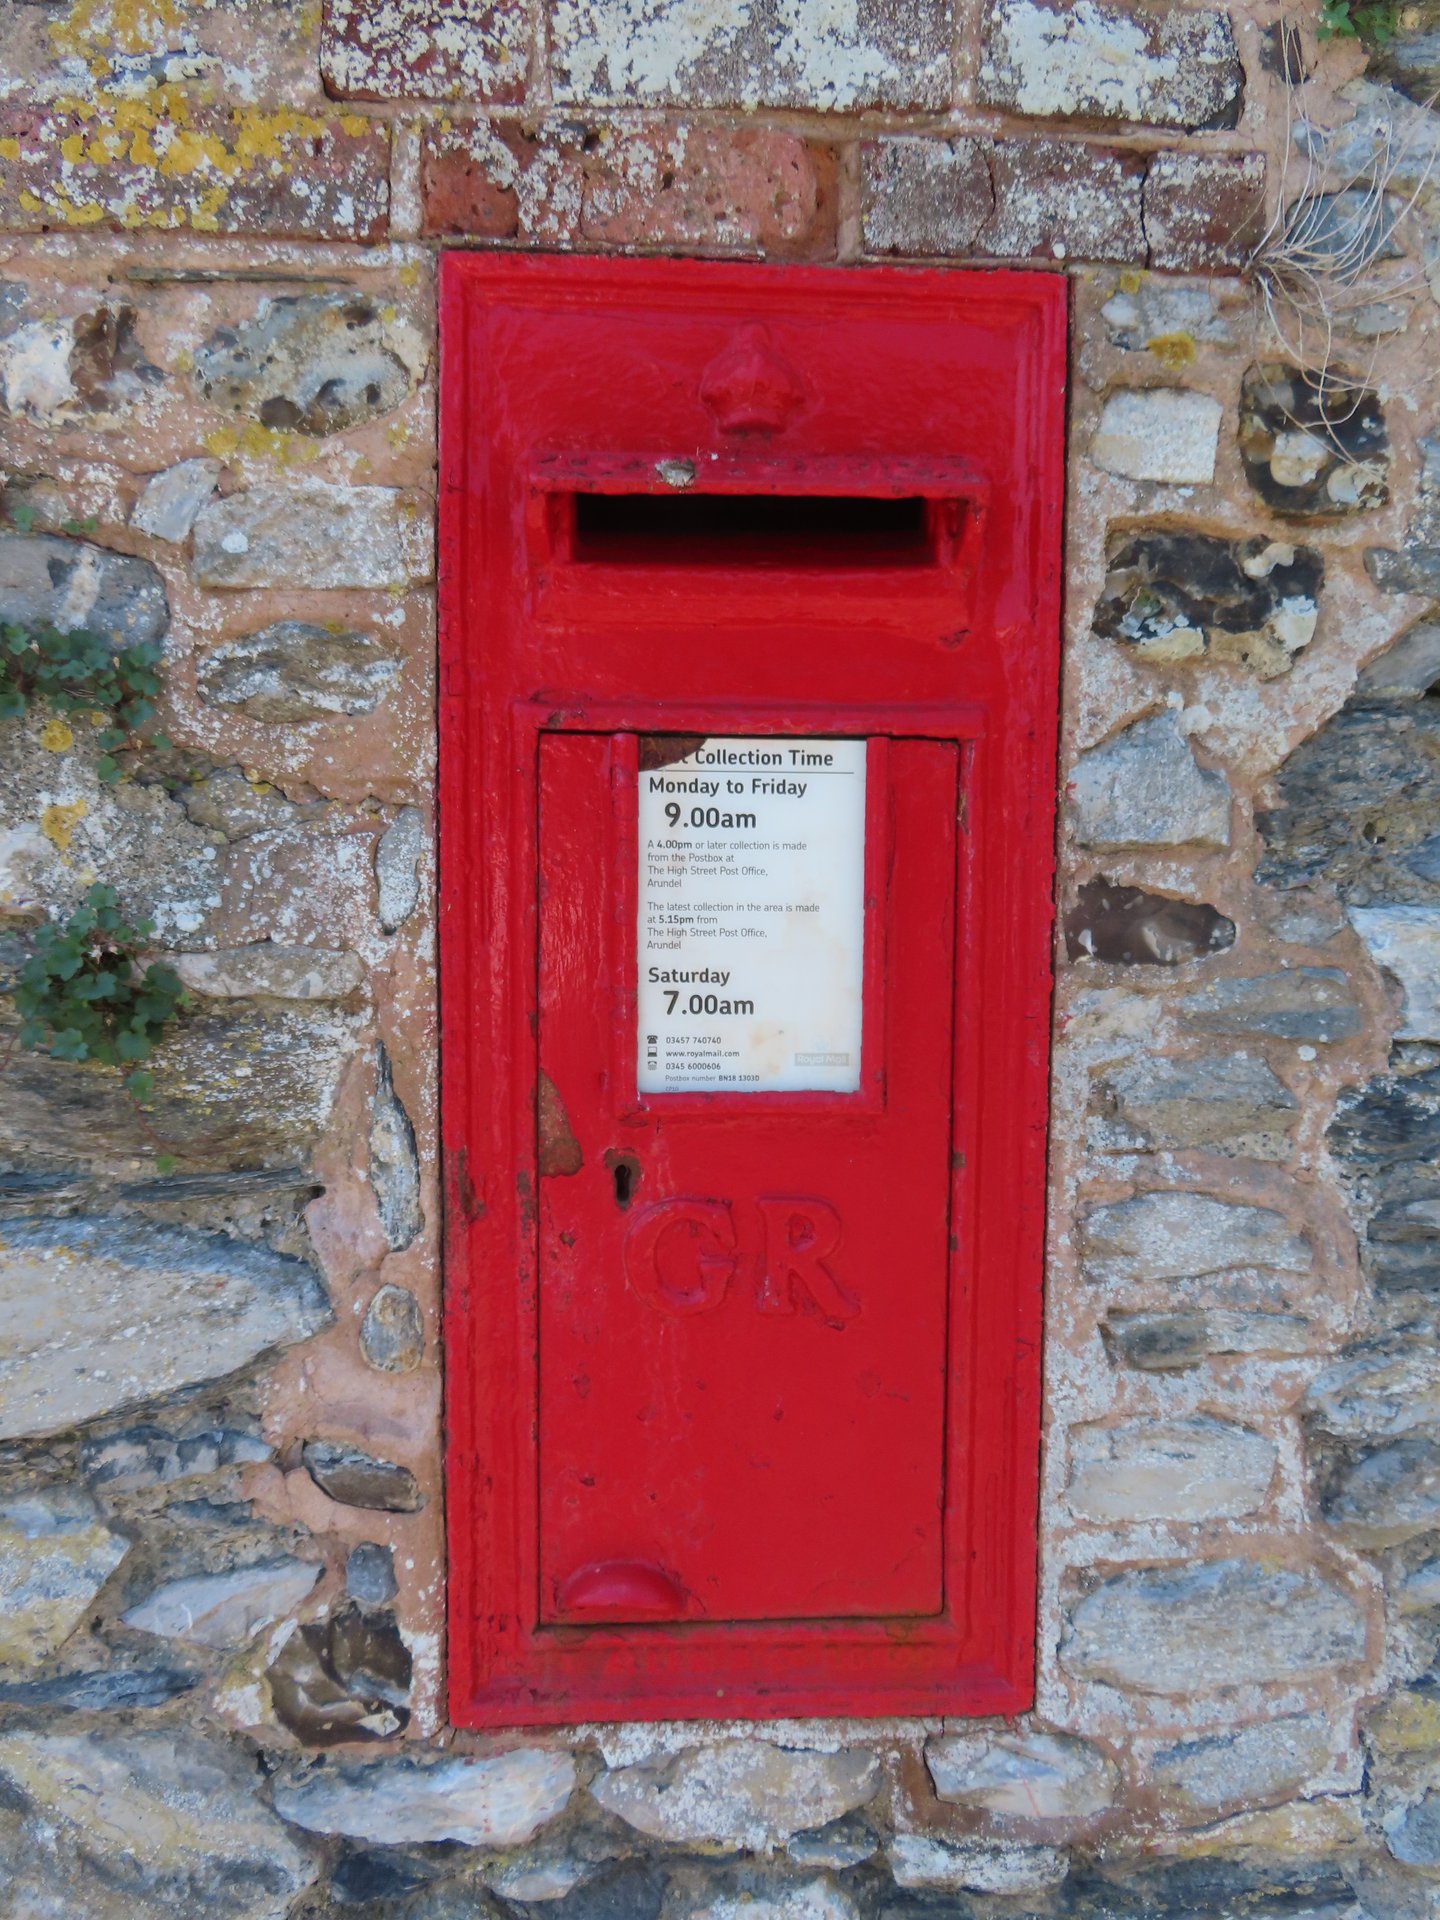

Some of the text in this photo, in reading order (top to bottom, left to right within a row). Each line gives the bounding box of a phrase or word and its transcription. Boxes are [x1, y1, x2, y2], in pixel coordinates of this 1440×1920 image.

[695, 749, 782, 766] Collection
[789, 750, 834, 766] Time
[649, 777, 807, 798] Monday to Friday
[664, 803, 757, 828] 9.00am
[648, 840, 654, 848] A
[657, 840, 692, 850] 4.00pm
[707, 841, 726, 849] later
[730, 841, 769, 850] collection
[773, 842, 780, 850] is
[782, 842, 807, 850] made
[672, 854, 686, 862] the
[689, 854, 723, 862] Postbox
[648, 866, 768, 877] The High Street Post Office,
[648, 879, 682, 887] Arundel
[648, 902, 664, 911] The
[667, 902, 690, 911] latest
[693, 903, 733, 911] collection
[747, 904, 761, 912] the
[785, 904, 792, 912] is
[796, 904, 820, 912] made
[647, 915, 718, 926] at 5.15pm from
[648, 928, 664, 936] The
[667, 928, 687, 938] High
[690, 928, 716, 937] Street
[719, 929, 738, 937] Post
[647, 941, 681, 949] Arundel
[648, 968, 730, 986] Saturday
[663, 991, 754, 1015] 7.00am
[666, 1050, 739, 1058] www.royalmail.com
